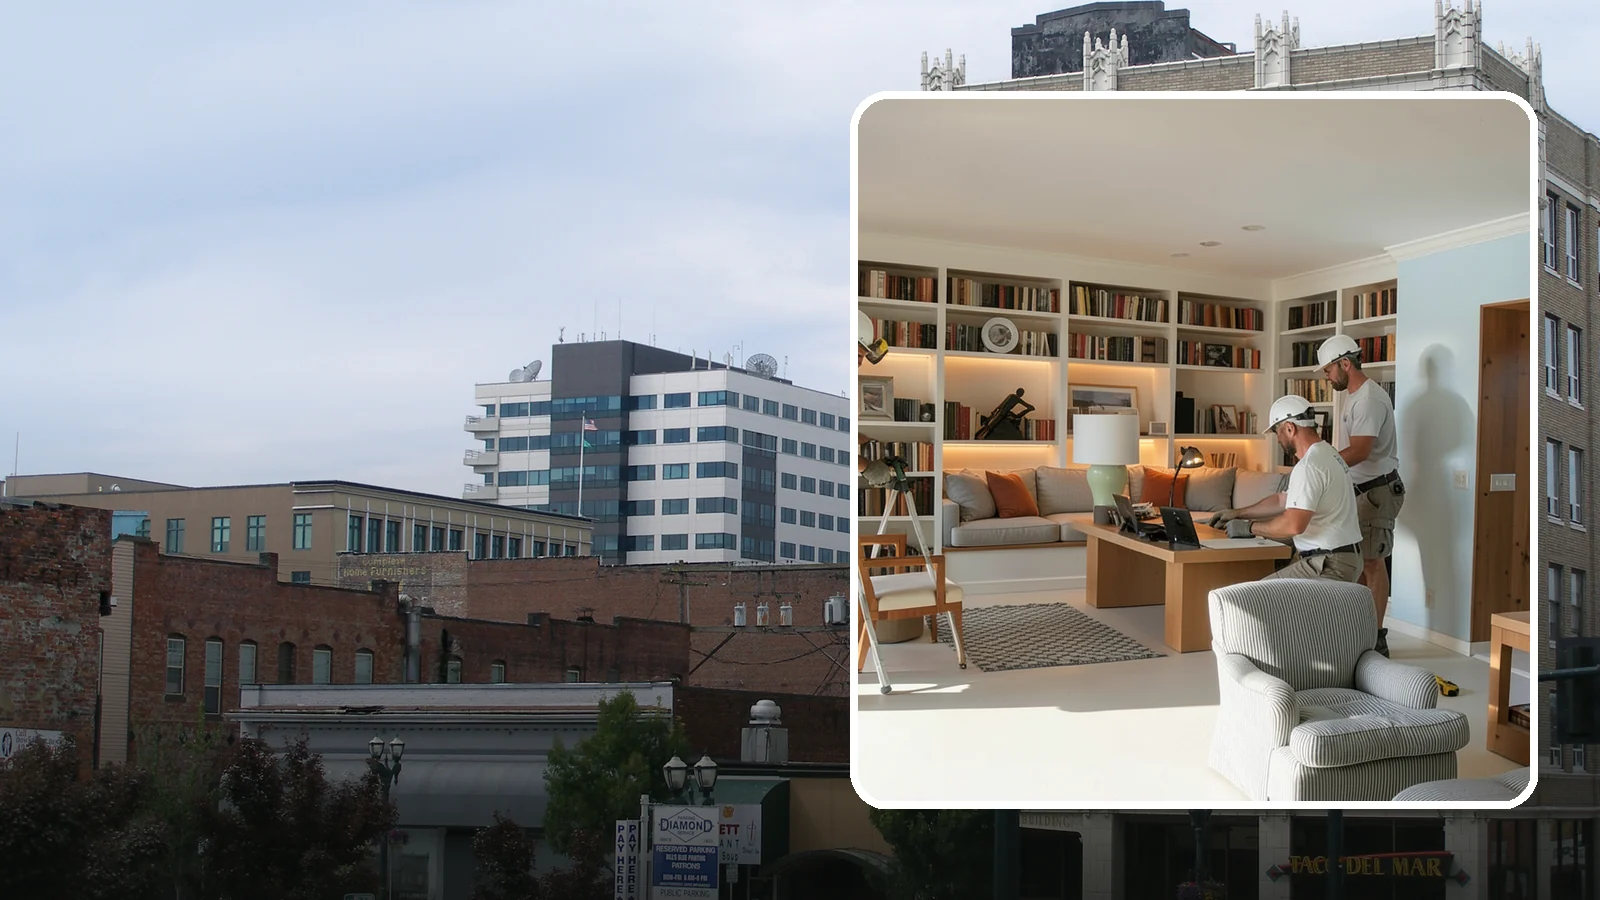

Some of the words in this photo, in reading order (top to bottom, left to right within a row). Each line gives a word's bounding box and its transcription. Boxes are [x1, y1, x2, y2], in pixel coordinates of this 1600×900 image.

[660, 818, 713, 833] DIAMOND
[1021, 815, 1070, 828] BUILDING
[617, 825, 625, 852] PAY
[628, 824, 637, 852] PAY
[656, 845, 688, 853] RESERVED
[616, 856, 625, 894] HERE
[627, 856, 636, 894] HERE
[671, 862, 701, 870] PATRONS
[1289, 855, 1329, 874] TAC
[1346, 856, 1384, 875] DEL
[1392, 857, 1442, 877] MAR
[660, 889, 682, 897] PUBLIC
[683, 890, 710, 898] PARKING
